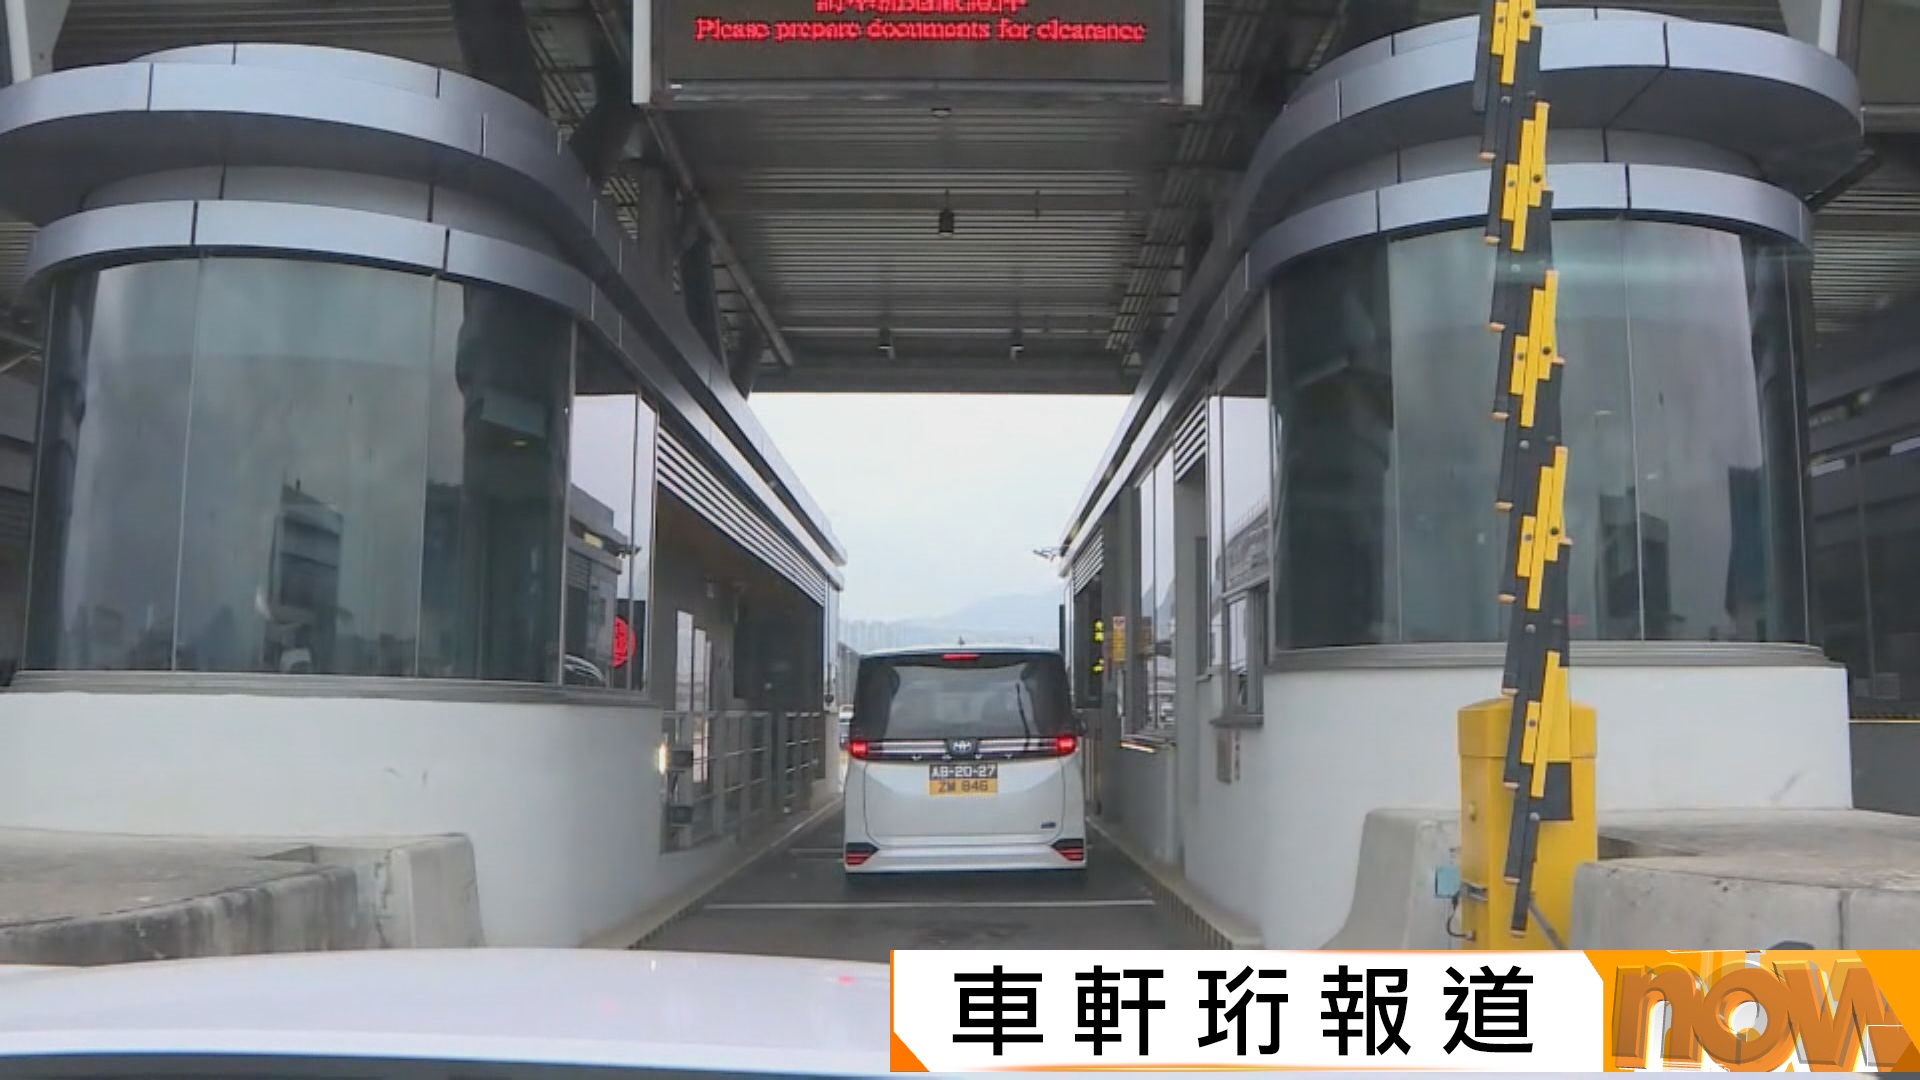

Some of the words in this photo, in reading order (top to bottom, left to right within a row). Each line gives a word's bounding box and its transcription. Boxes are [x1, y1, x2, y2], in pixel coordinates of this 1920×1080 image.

[695, 18, 769, 41] Please
[774, 22, 861, 42] prepare
[865, 18, 989, 41] documents
[997, 18, 1030, 41] for
[1035, 18, 1146, 42] clearance
